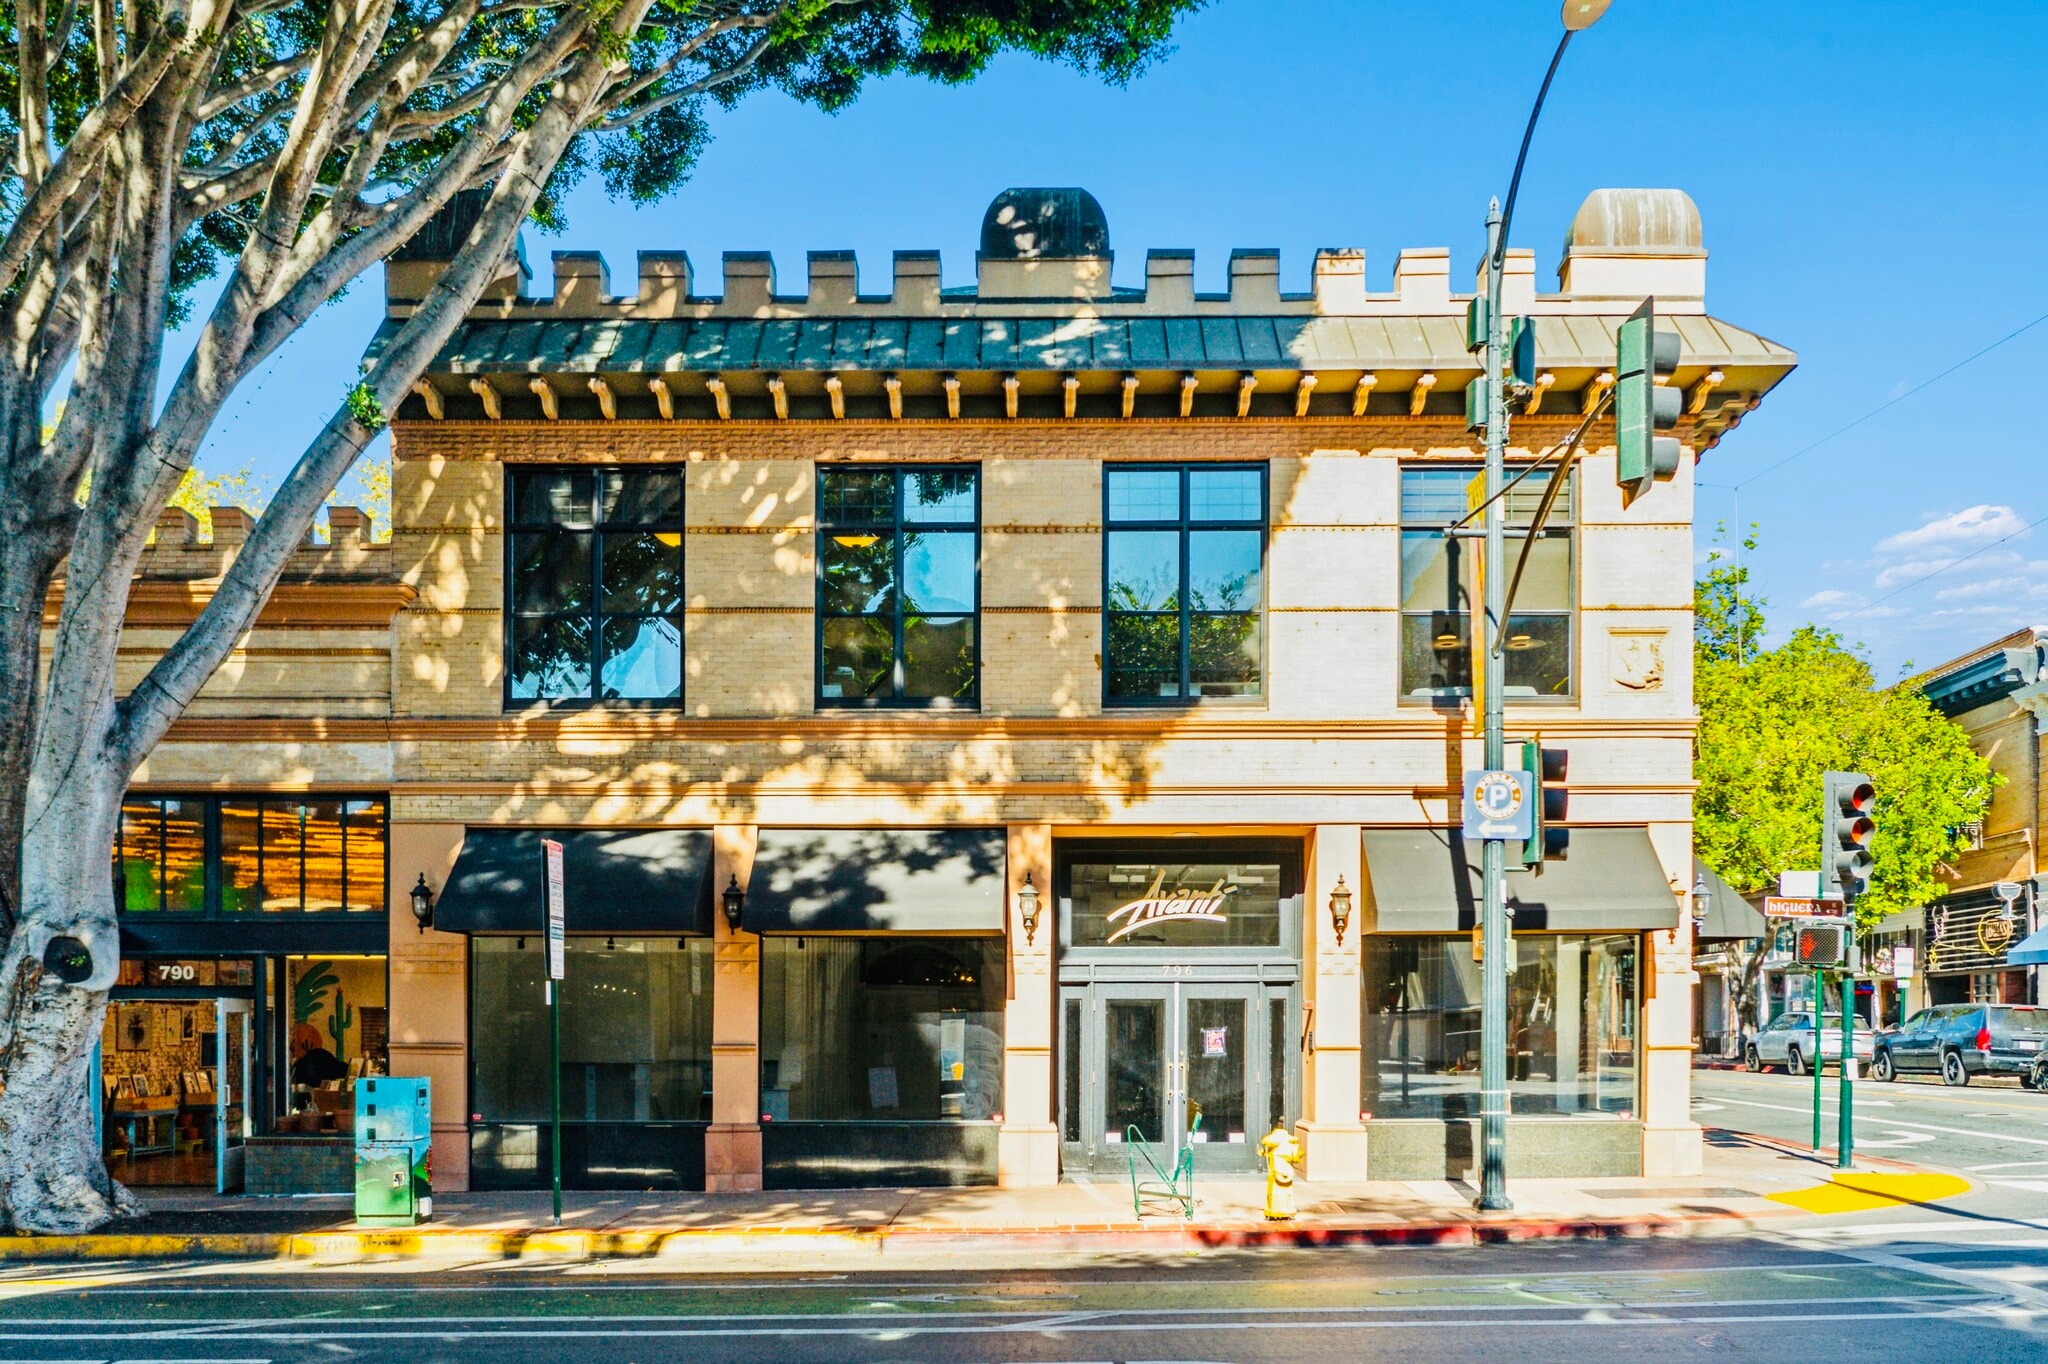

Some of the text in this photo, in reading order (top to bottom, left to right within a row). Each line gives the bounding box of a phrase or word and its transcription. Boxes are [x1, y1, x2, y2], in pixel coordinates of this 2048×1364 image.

[1490, 784, 1508, 808] P
[1107, 868, 1238, 926] Avanti
[159, 965, 194, 980] 790
[1162, 965, 1193, 976] 796
